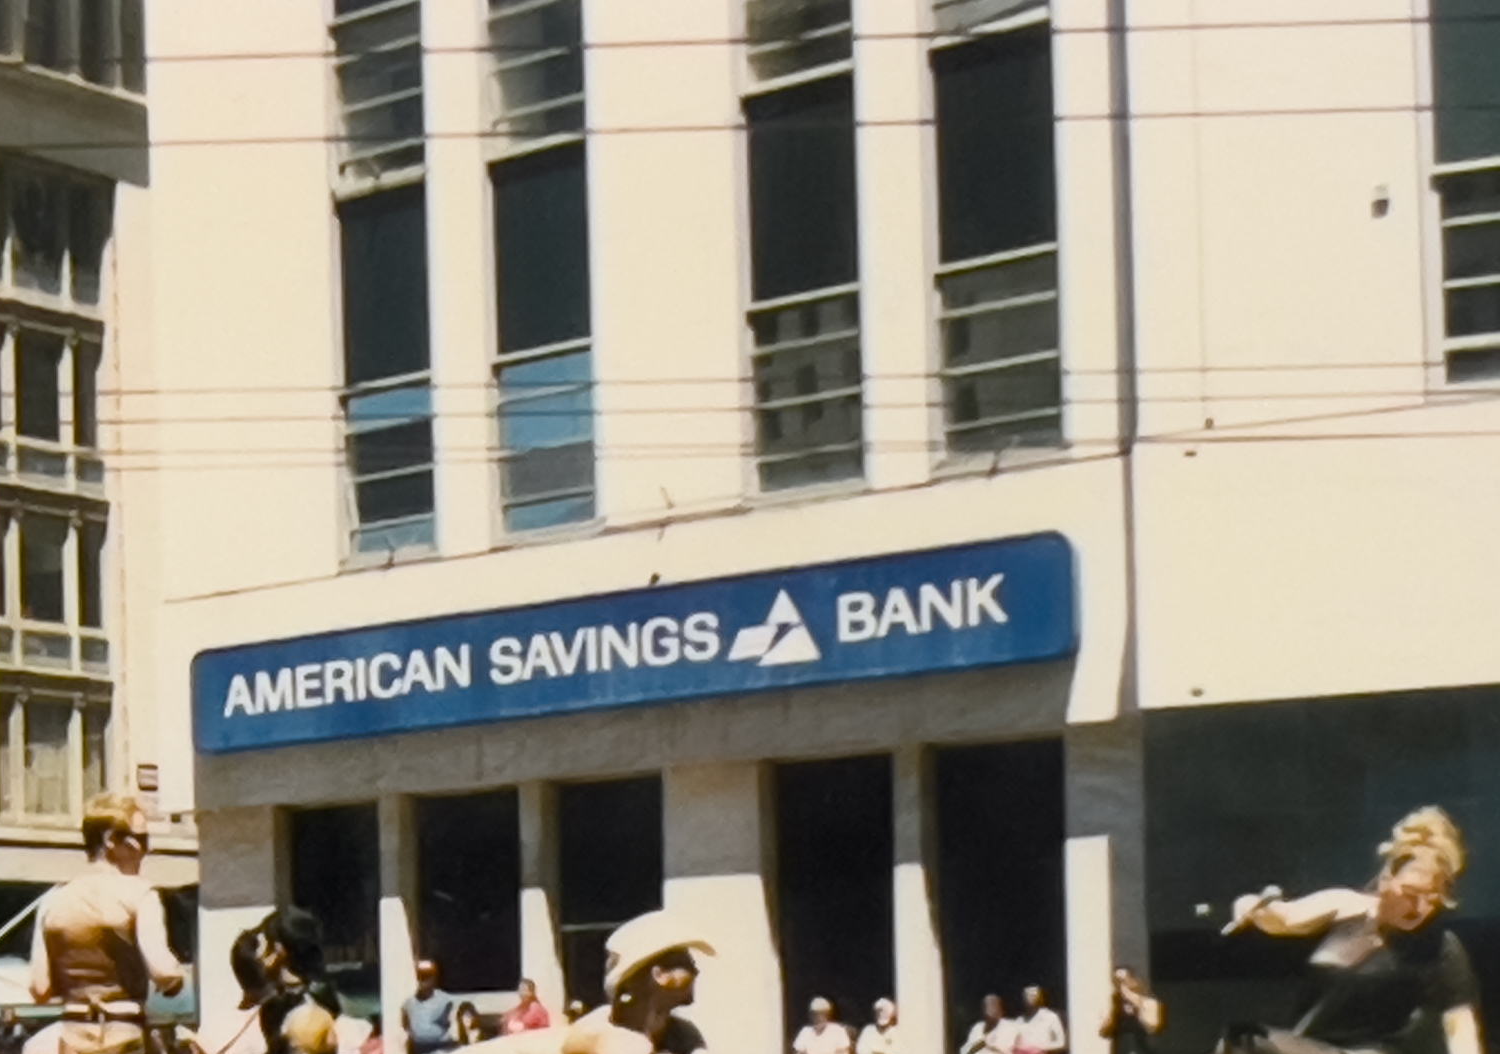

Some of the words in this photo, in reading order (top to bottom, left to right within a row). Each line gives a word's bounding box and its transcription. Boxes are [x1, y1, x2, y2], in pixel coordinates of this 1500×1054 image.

[223, 643, 471, 718] AMERICAN
[489, 611, 721, 685] SAVINGS
[836, 573, 1009, 643] BANK
